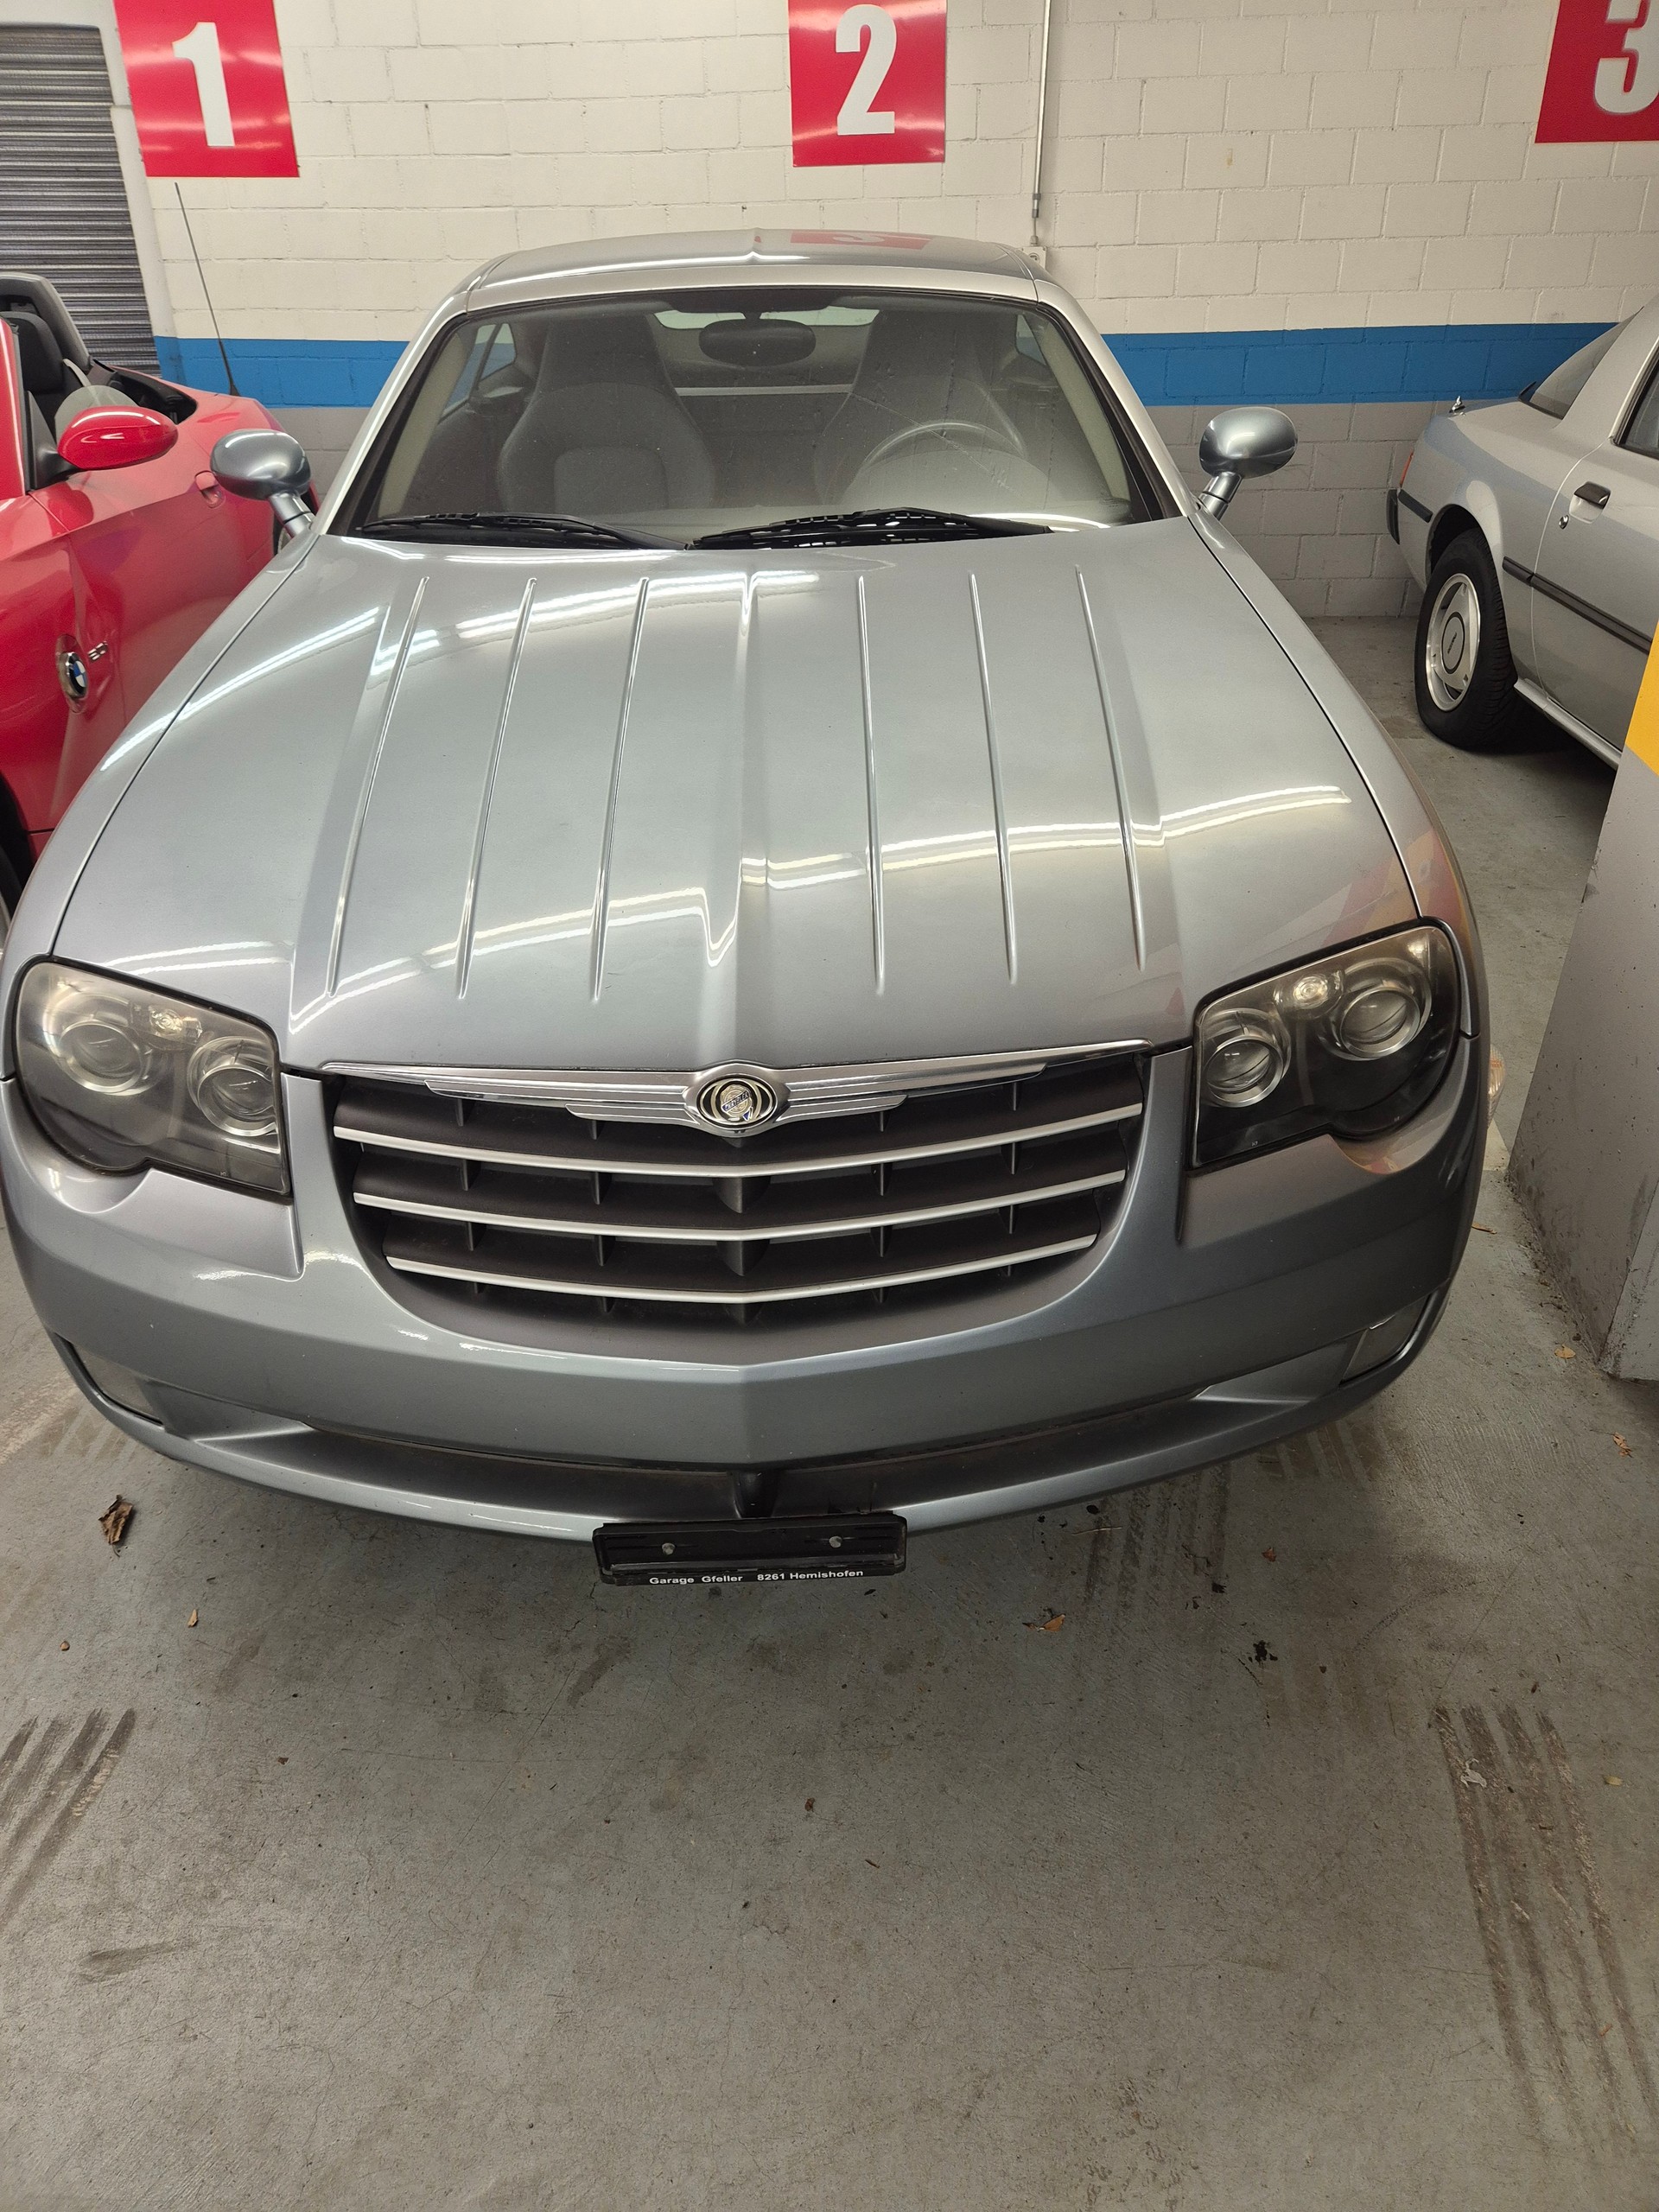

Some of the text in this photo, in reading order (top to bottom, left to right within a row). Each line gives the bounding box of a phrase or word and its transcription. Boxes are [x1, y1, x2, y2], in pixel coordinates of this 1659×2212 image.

[172, 22, 235, 147] 1
[836, 3, 897, 136] 2
[1594, 0, 1659, 114] 3
[702, 1574, 743, 1583] Gfeller
[757, 1573, 785, 1581] 8261
[790, 1570, 863, 1580] Hemishofen
